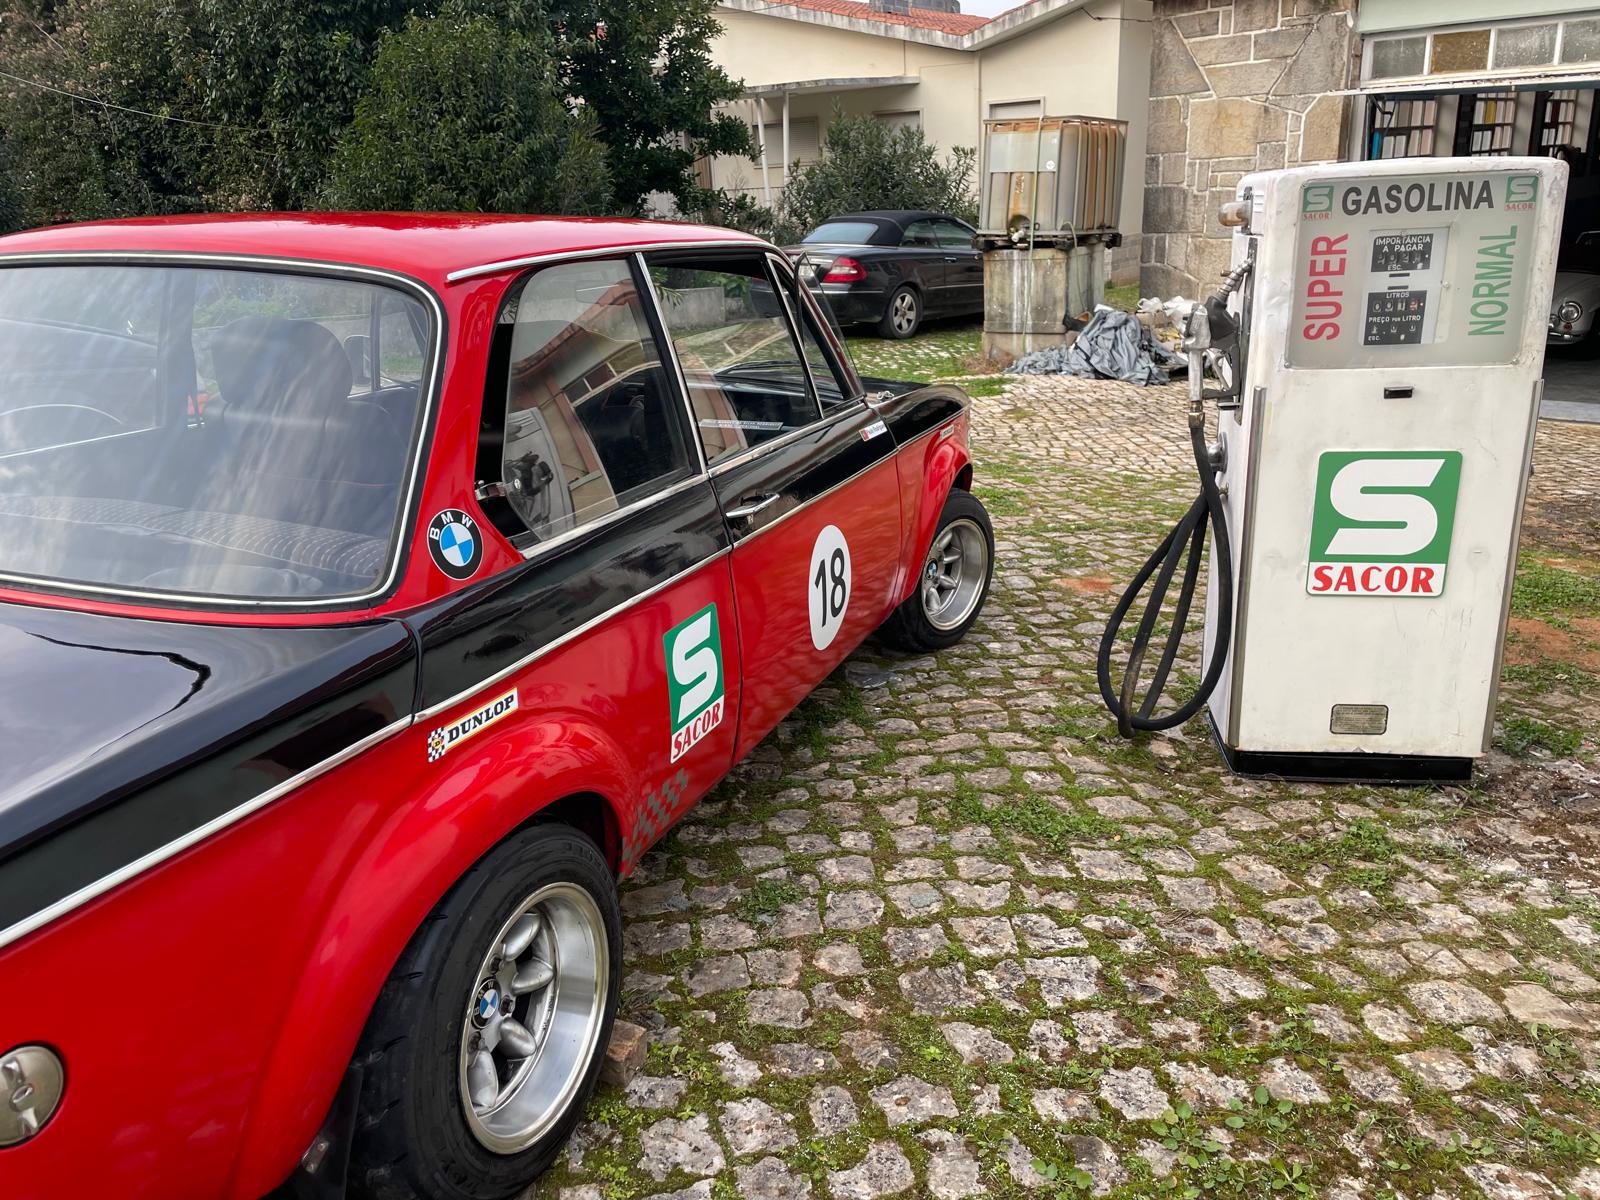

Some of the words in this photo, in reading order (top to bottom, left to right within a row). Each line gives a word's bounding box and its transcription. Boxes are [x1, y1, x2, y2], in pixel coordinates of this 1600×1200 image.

[1341, 180, 1494, 216] GASOLINA
[1504, 203, 1534, 211] SACOR
[1303, 212, 1330, 220] SACOR
[1382, 245, 1389, 253] A
[1394, 243, 1424, 251] PAGAR
[1303, 233, 1349, 340] SUPER
[1467, 225, 1518, 336] NORMAL
[1368, 316, 1390, 324] PREÇO
[1402, 314, 1422, 322] LITRO
[430, 512, 472, 541] BMW
[814, 547, 847, 628] 18
[1311, 565, 1436, 593] SACOR
[447, 694, 514, 744] DUNLOP
[671, 702, 722, 759] SACOR
